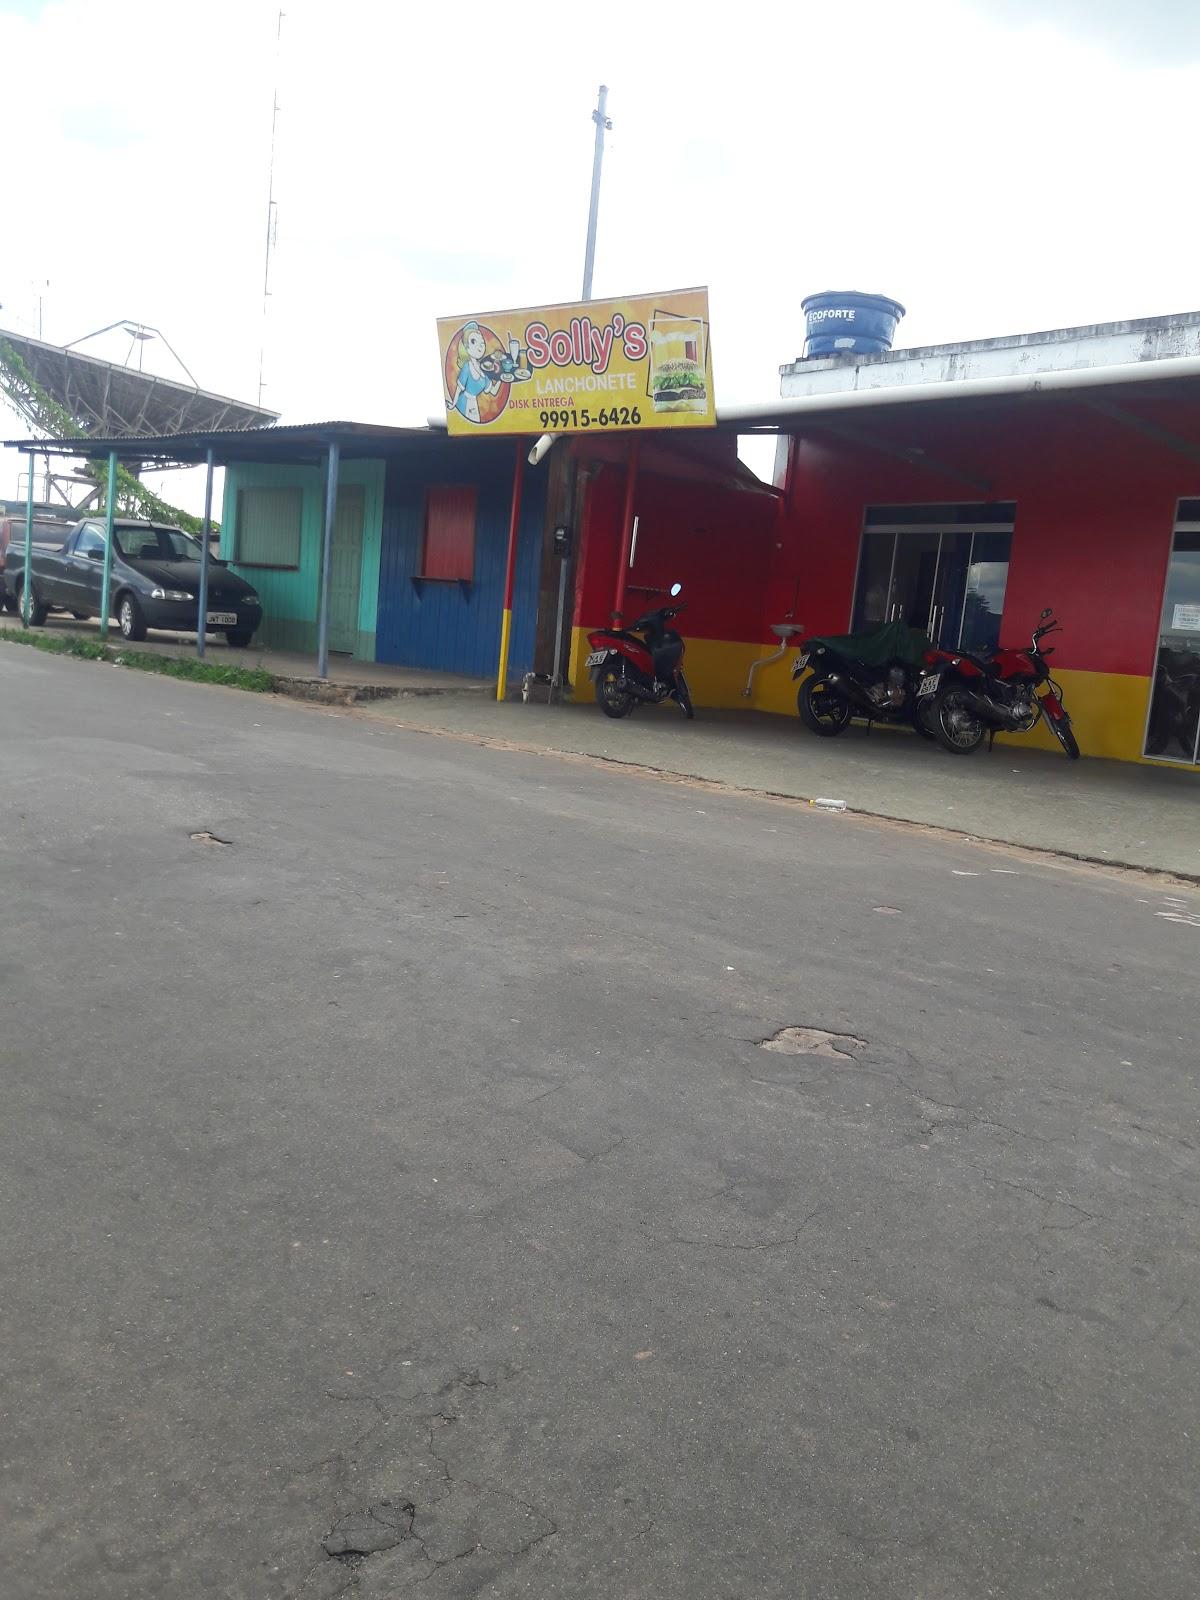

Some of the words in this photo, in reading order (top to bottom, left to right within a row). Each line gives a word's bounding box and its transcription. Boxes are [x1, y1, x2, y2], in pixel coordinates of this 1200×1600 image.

[809, 309, 855, 321] ECOFORTE
[526, 313, 648, 374] Solly's
[536, 374, 636, 394] LANCHONETE
[509, 400, 530, 409] DISK
[532, 397, 574, 408] ENTREGA
[540, 407, 641, 427] 99915-6426
